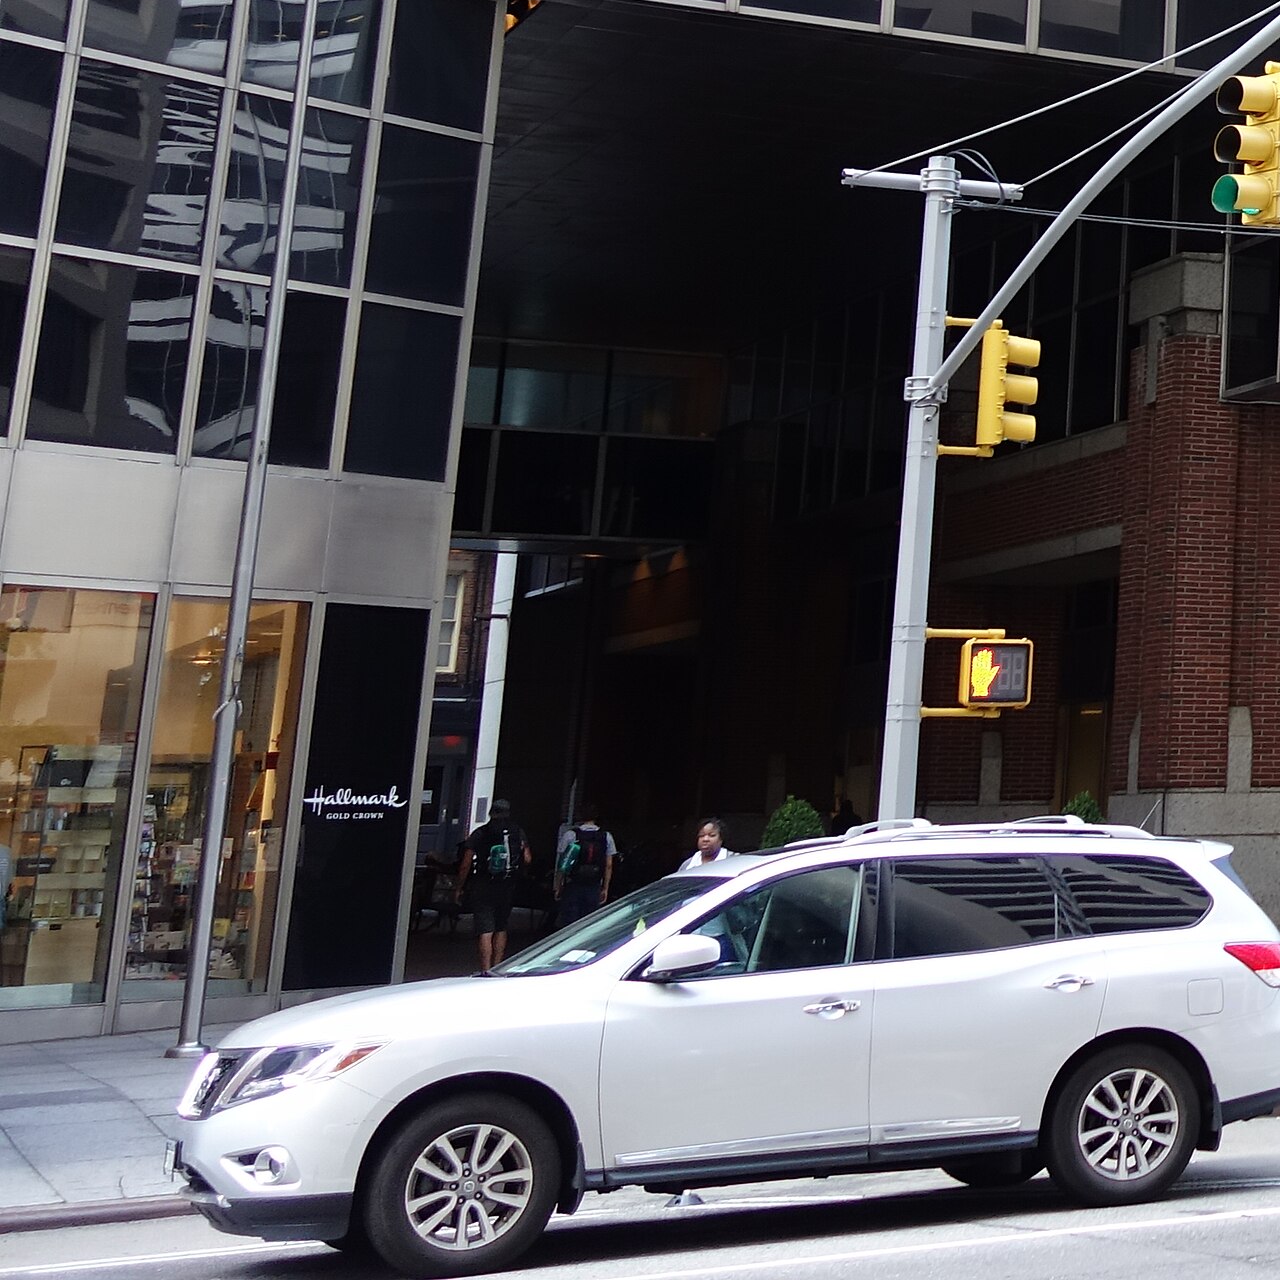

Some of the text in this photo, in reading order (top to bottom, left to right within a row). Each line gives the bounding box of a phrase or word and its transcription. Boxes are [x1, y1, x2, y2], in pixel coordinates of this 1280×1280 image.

[303, 785, 408, 816] Hallmark
[326, 812, 384, 820] GOLD CROWN
